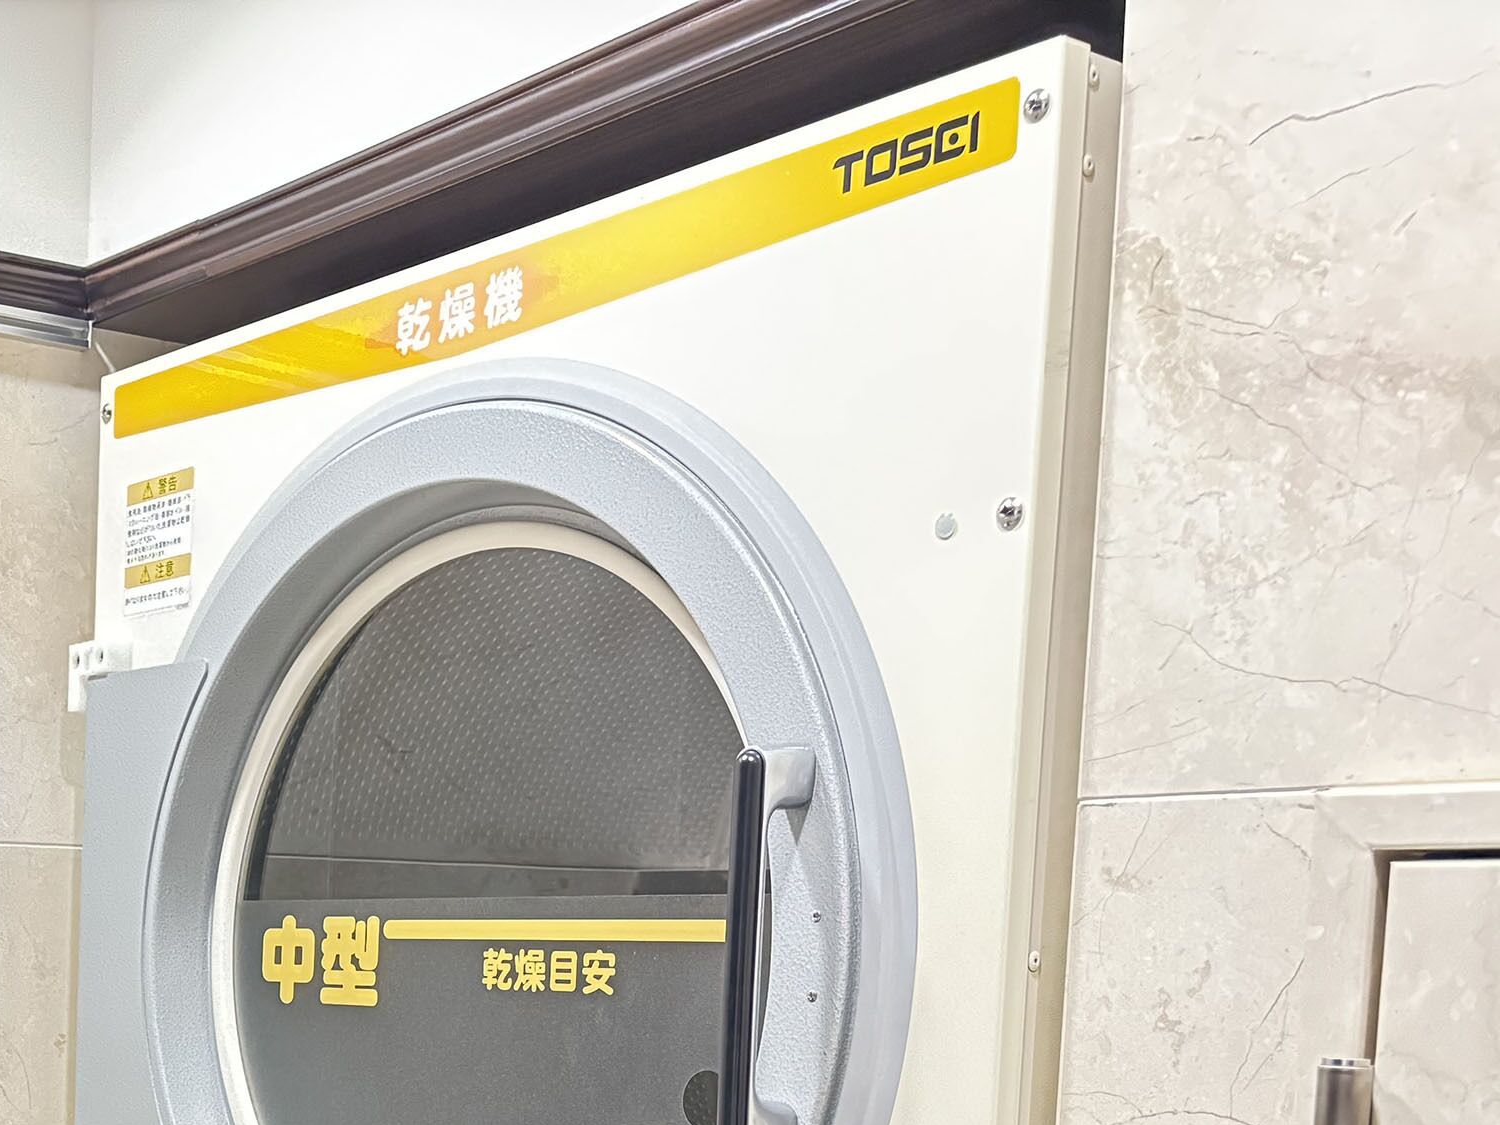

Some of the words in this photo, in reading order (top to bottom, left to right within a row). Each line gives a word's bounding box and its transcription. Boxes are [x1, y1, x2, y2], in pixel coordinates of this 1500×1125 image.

[833, 111, 981, 193] TOSEI
[394, 265, 524, 357] 乾燥機
[262, 914, 380, 1007] 中型
[481, 947, 617, 996] 乾燥目安
